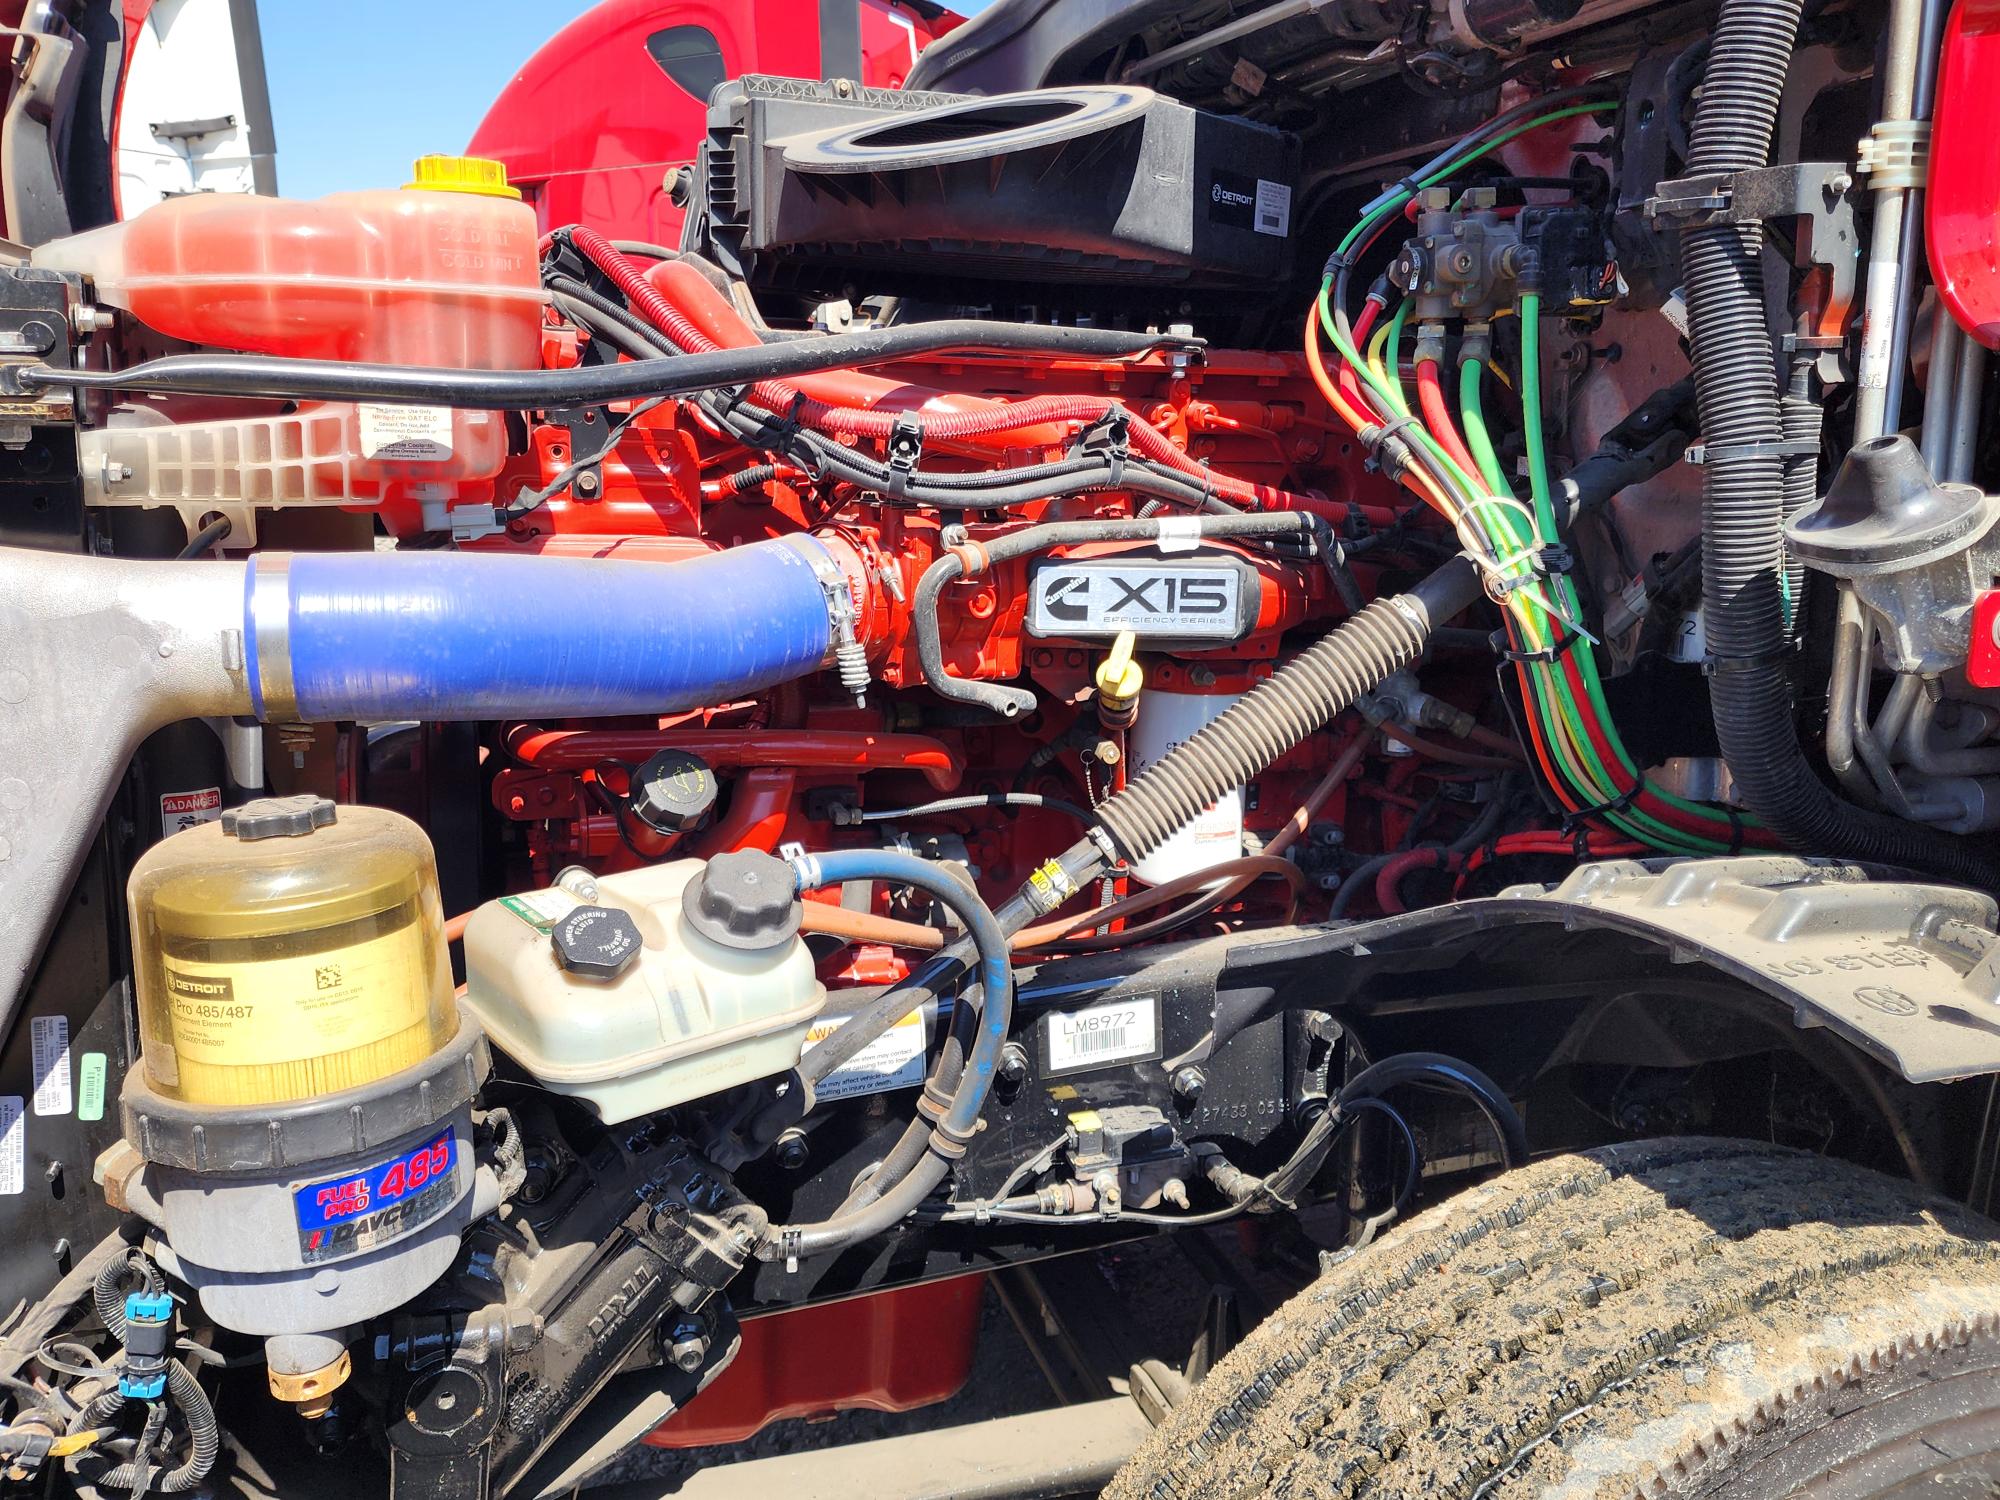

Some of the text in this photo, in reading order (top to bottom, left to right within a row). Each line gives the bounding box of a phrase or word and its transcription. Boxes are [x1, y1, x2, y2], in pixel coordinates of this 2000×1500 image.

[1222, 190, 1253, 205] DETROIT
[441, 253, 484, 269] COLD
[1044, 575, 1088, 606] Cummins
[1104, 577, 1228, 613] X15
[1103, 616, 1177, 624] EFFICIENCY
[177, 795, 219, 810] DANGER
[565, 911, 608, 947] POWER STEERING
[575, 918, 594, 935] FLUID
[597, 929, 623, 952] OVERFILL
[609, 938, 631, 957] DO NOT
[176, 980, 227, 994] DETROIT
[176, 999, 193, 1016] Pro
[195, 1005, 254, 1019] 485/487
[202, 1019, 232, 1028] Element
[1063, 1011, 1136, 1035] LM8972
[877, 1052, 889, 1061] may
[890, 1048, 912, 1057] contact
[853, 1062, 877, 1071] causing
[828, 1080, 840, 1088] may
[841, 1075, 859, 1083] affect
[860, 1073, 881, 1081] vehicle
[815, 1088, 840, 1098] resulting
[849, 1084, 866, 1093] injury
[377, 1136, 450, 1199] 485
[317, 1178, 371, 1206] FUEL
[324, 1193, 370, 1220] PRO
[333, 1198, 416, 1244] DAVCO
